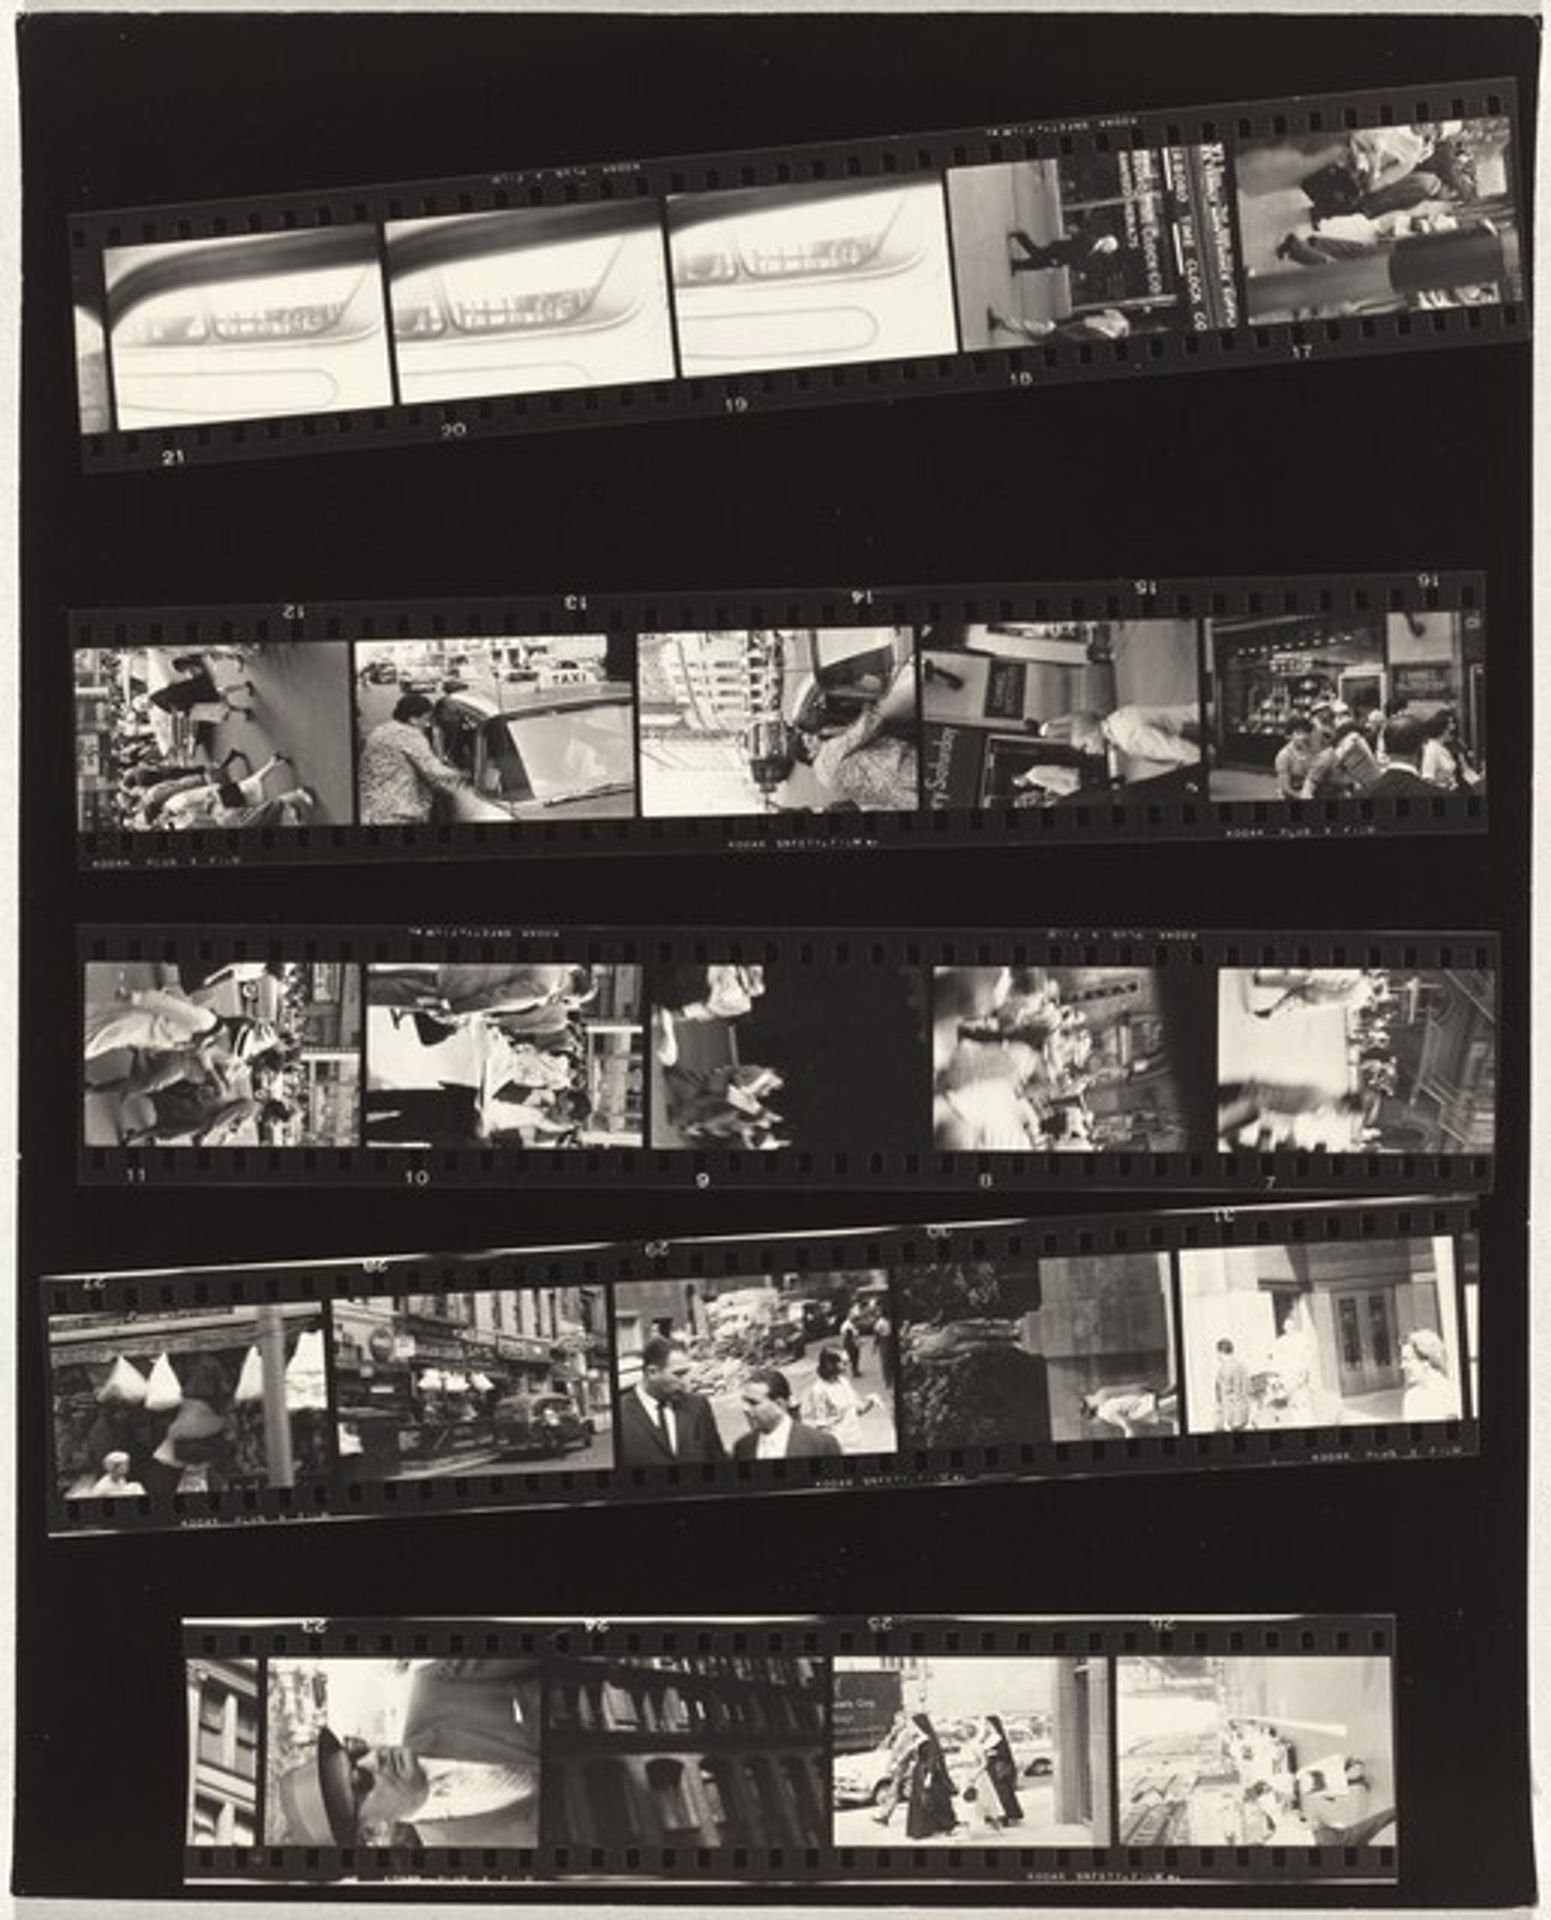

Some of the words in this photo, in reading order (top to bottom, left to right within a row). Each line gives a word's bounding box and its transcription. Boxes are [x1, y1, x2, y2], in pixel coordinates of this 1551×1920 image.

[1290, 344, 1314, 359] 17
[1008, 371, 1034, 386] 18
[725, 397, 749, 412] 19
[440, 423, 468, 438] 20
[161, 449, 186, 464] 21
[1134, 580, 1157, 596] 15
[1418, 574, 1439, 588] 16
[564, 595, 587, 611] 13
[851, 591, 873, 604] 14
[282, 605, 305, 619] 12
[552, 672, 587, 686] TAXI
[125, 1168, 146, 1182] 11
[404, 1169, 430, 1186] 10
[696, 1173, 710, 1189] 9
